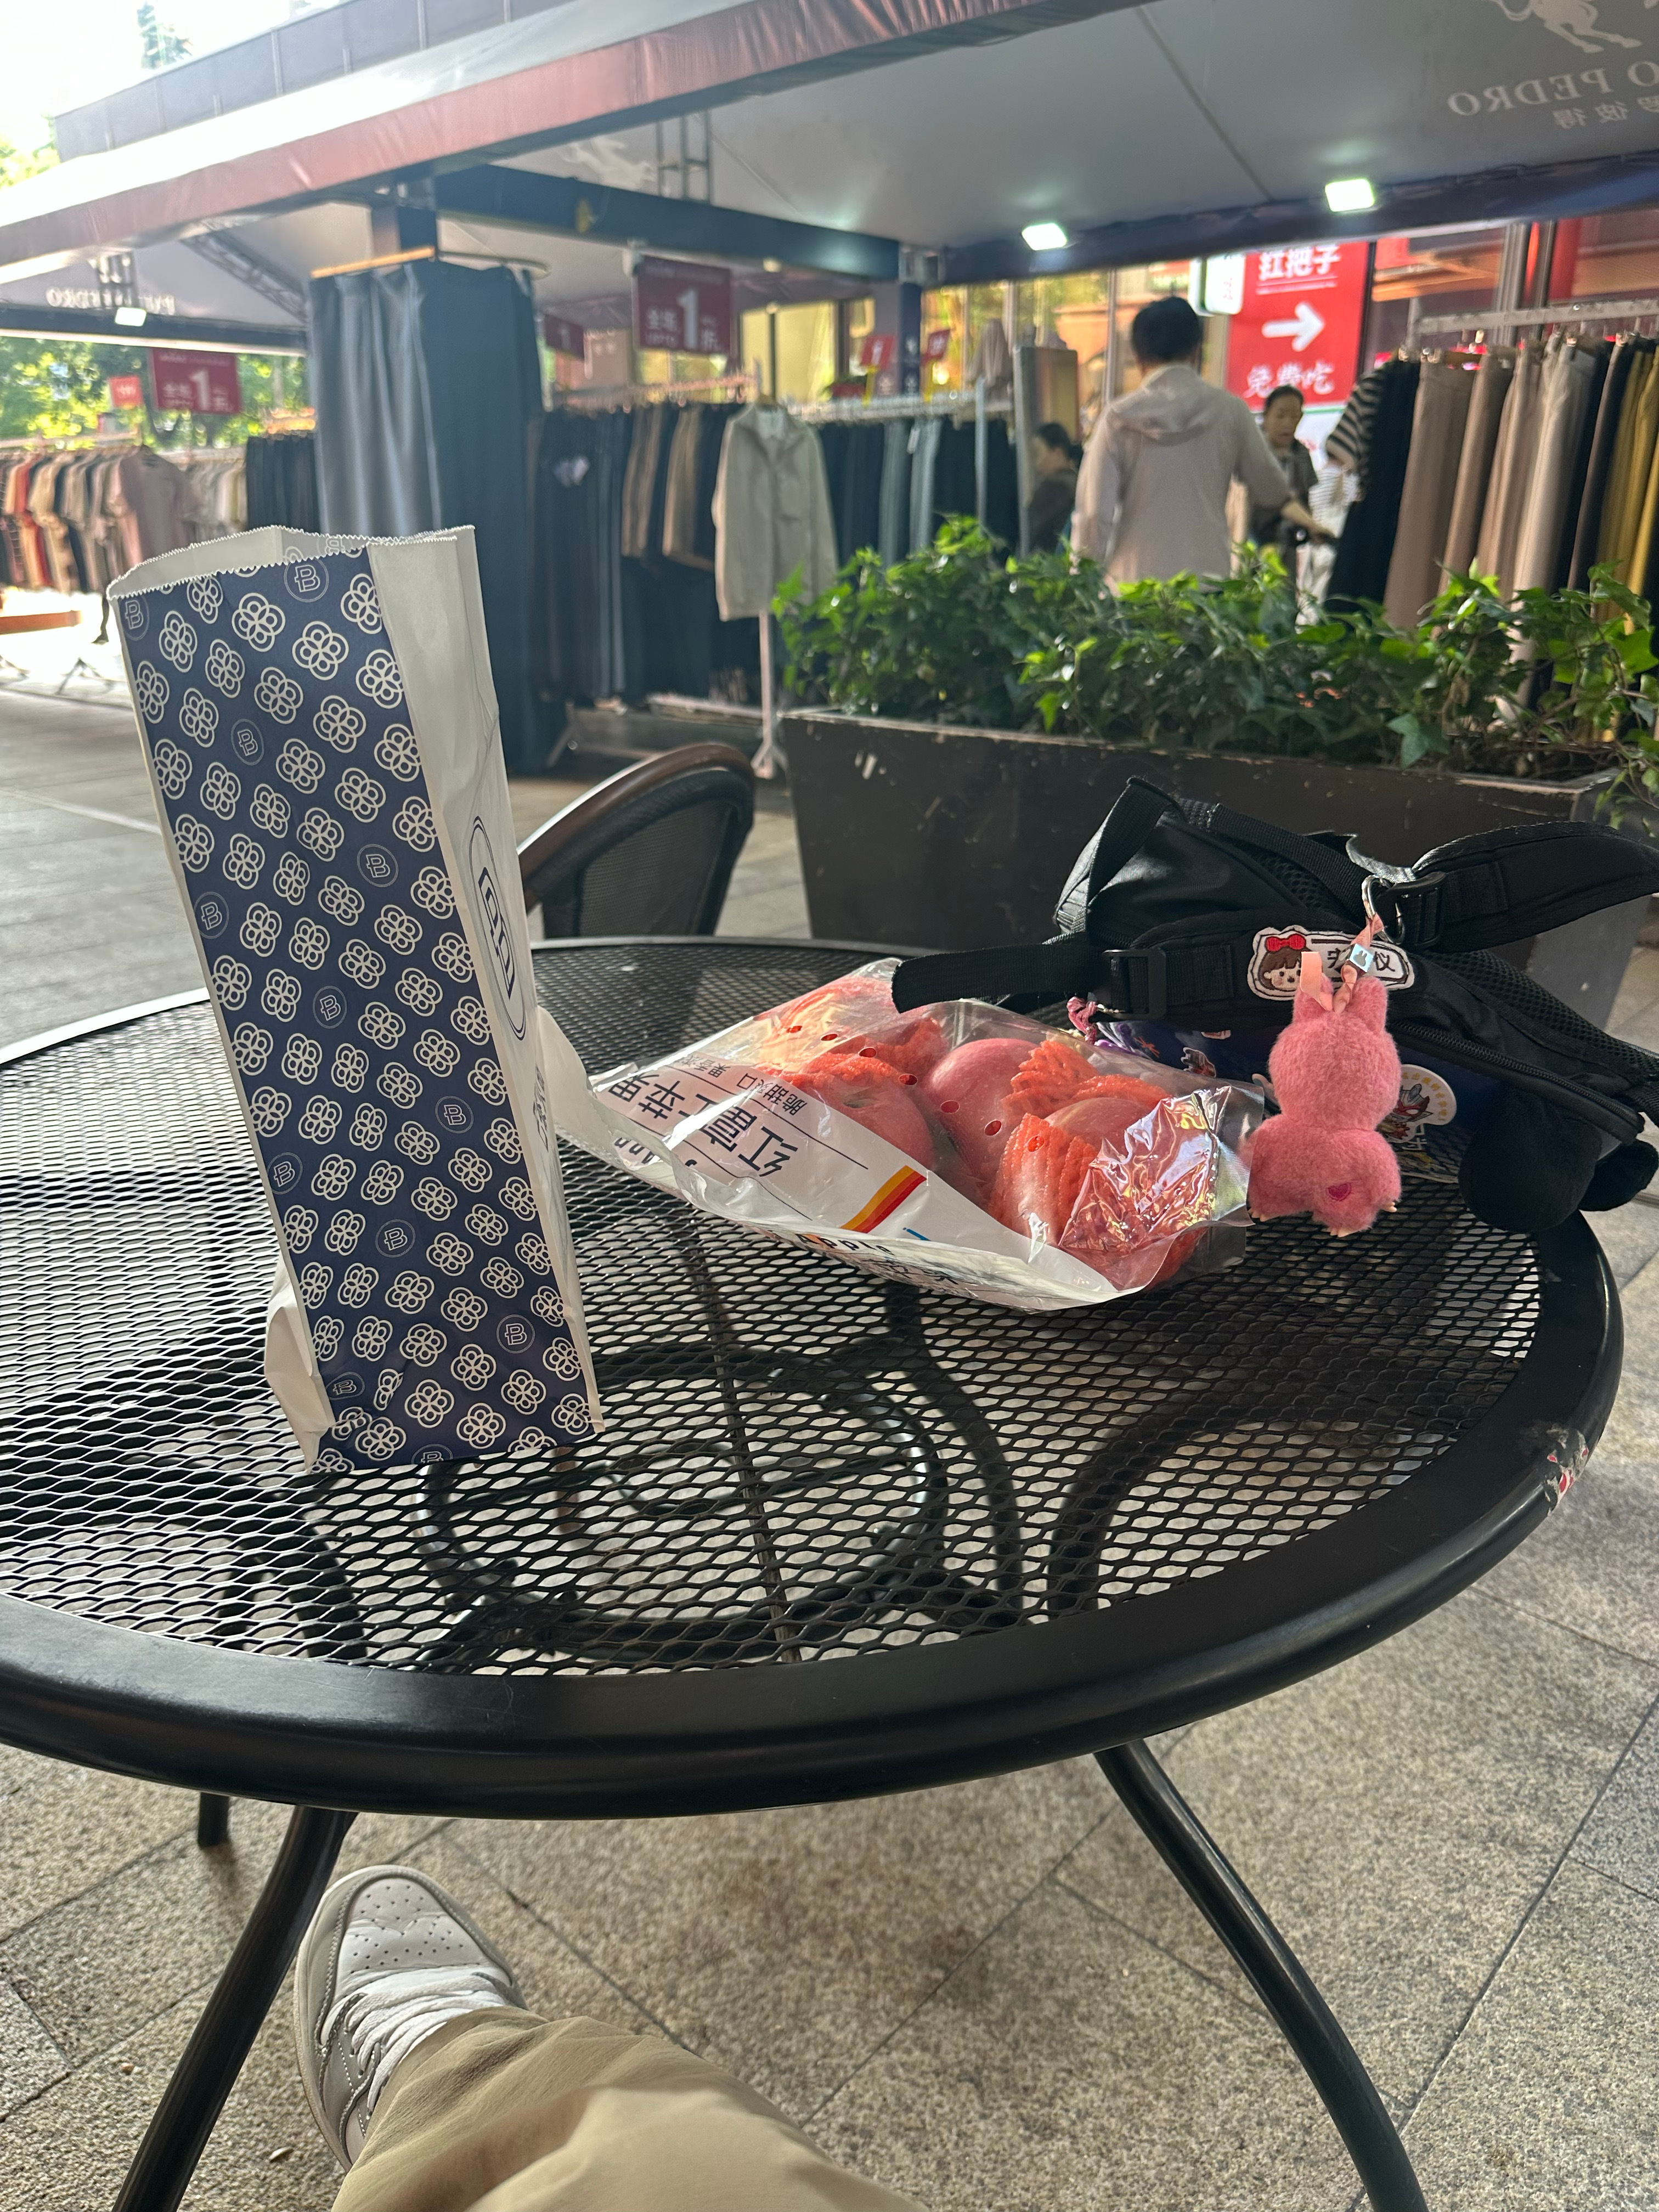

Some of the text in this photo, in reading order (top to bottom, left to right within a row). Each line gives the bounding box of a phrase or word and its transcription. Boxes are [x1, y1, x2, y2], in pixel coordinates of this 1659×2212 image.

[678, 289, 698, 349] 1
[190, 369, 210, 411] 1
[1243, 359, 1335, 399] 免费吃
[736, 1073, 808, 1116] 脆甜爽口
[796, 1233, 896, 1257] Apple
